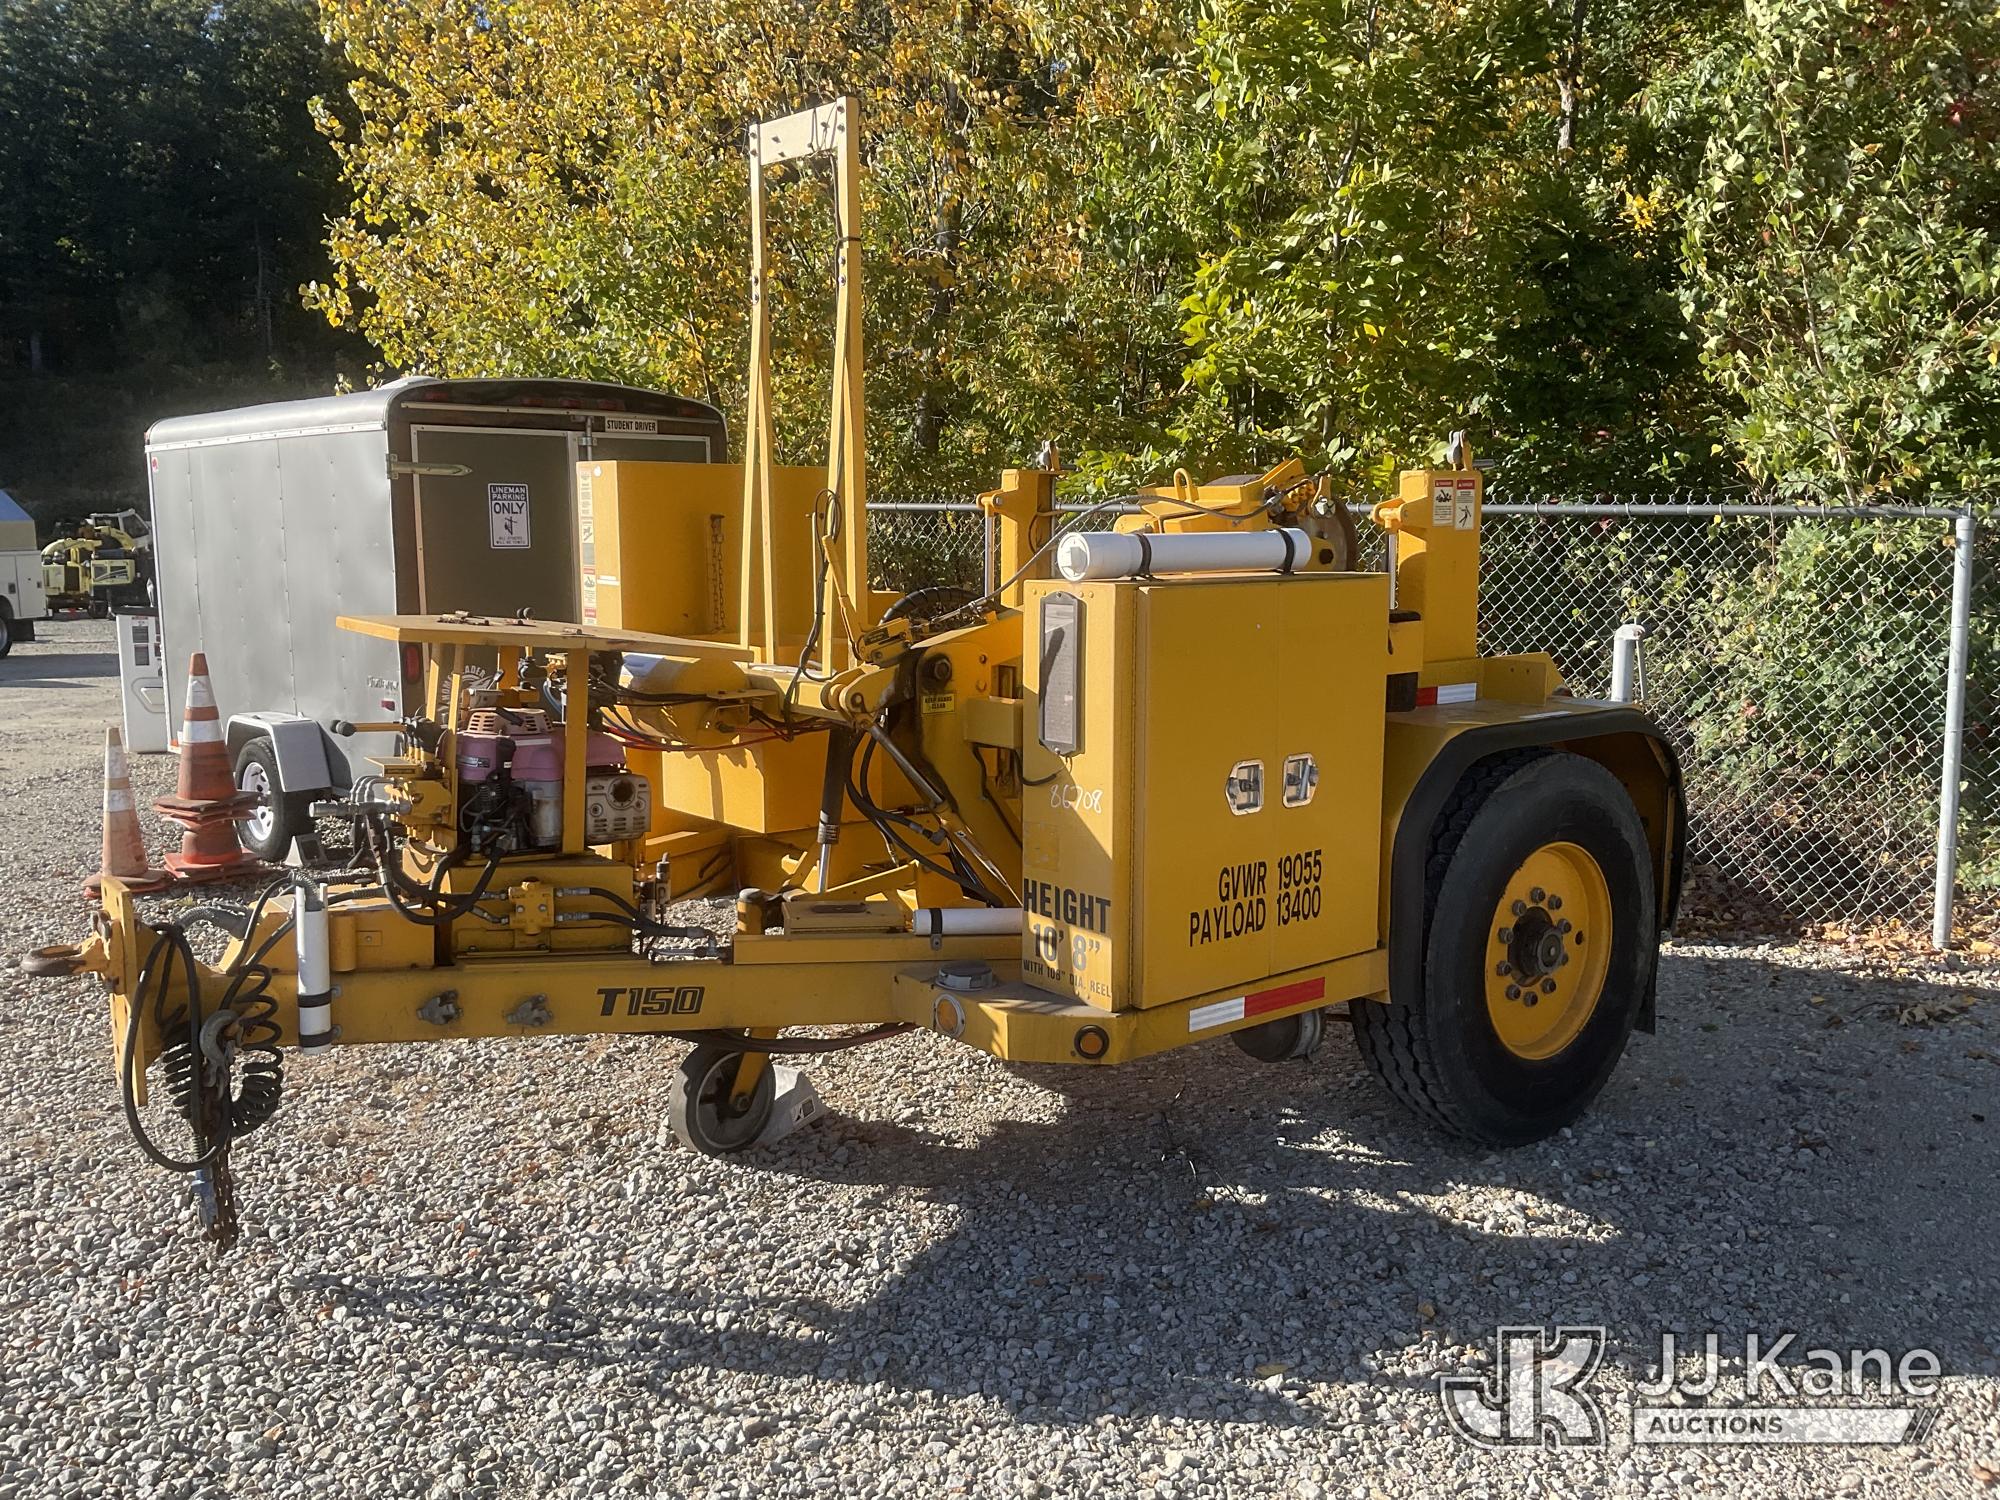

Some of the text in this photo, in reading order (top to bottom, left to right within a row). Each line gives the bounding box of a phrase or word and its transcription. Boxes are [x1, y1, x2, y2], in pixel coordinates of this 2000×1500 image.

[607, 419, 656, 432] STUDENT DRIVER
[491, 486, 525, 494] LINEMAN
[492, 493, 525, 501] PARKING
[494, 502, 525, 514] ONLY
[1050, 784, 1103, 814] 86708
[1219, 849, 1322, 903] GVWR 19055
[1023, 878, 1112, 934] HEIGHT
[1189, 885, 1321, 947] PAYLOAD 13400
[1023, 959, 1043, 975] WITH
[1069, 973, 1087, 990] DIA.
[596, 986, 706, 1016] T150
